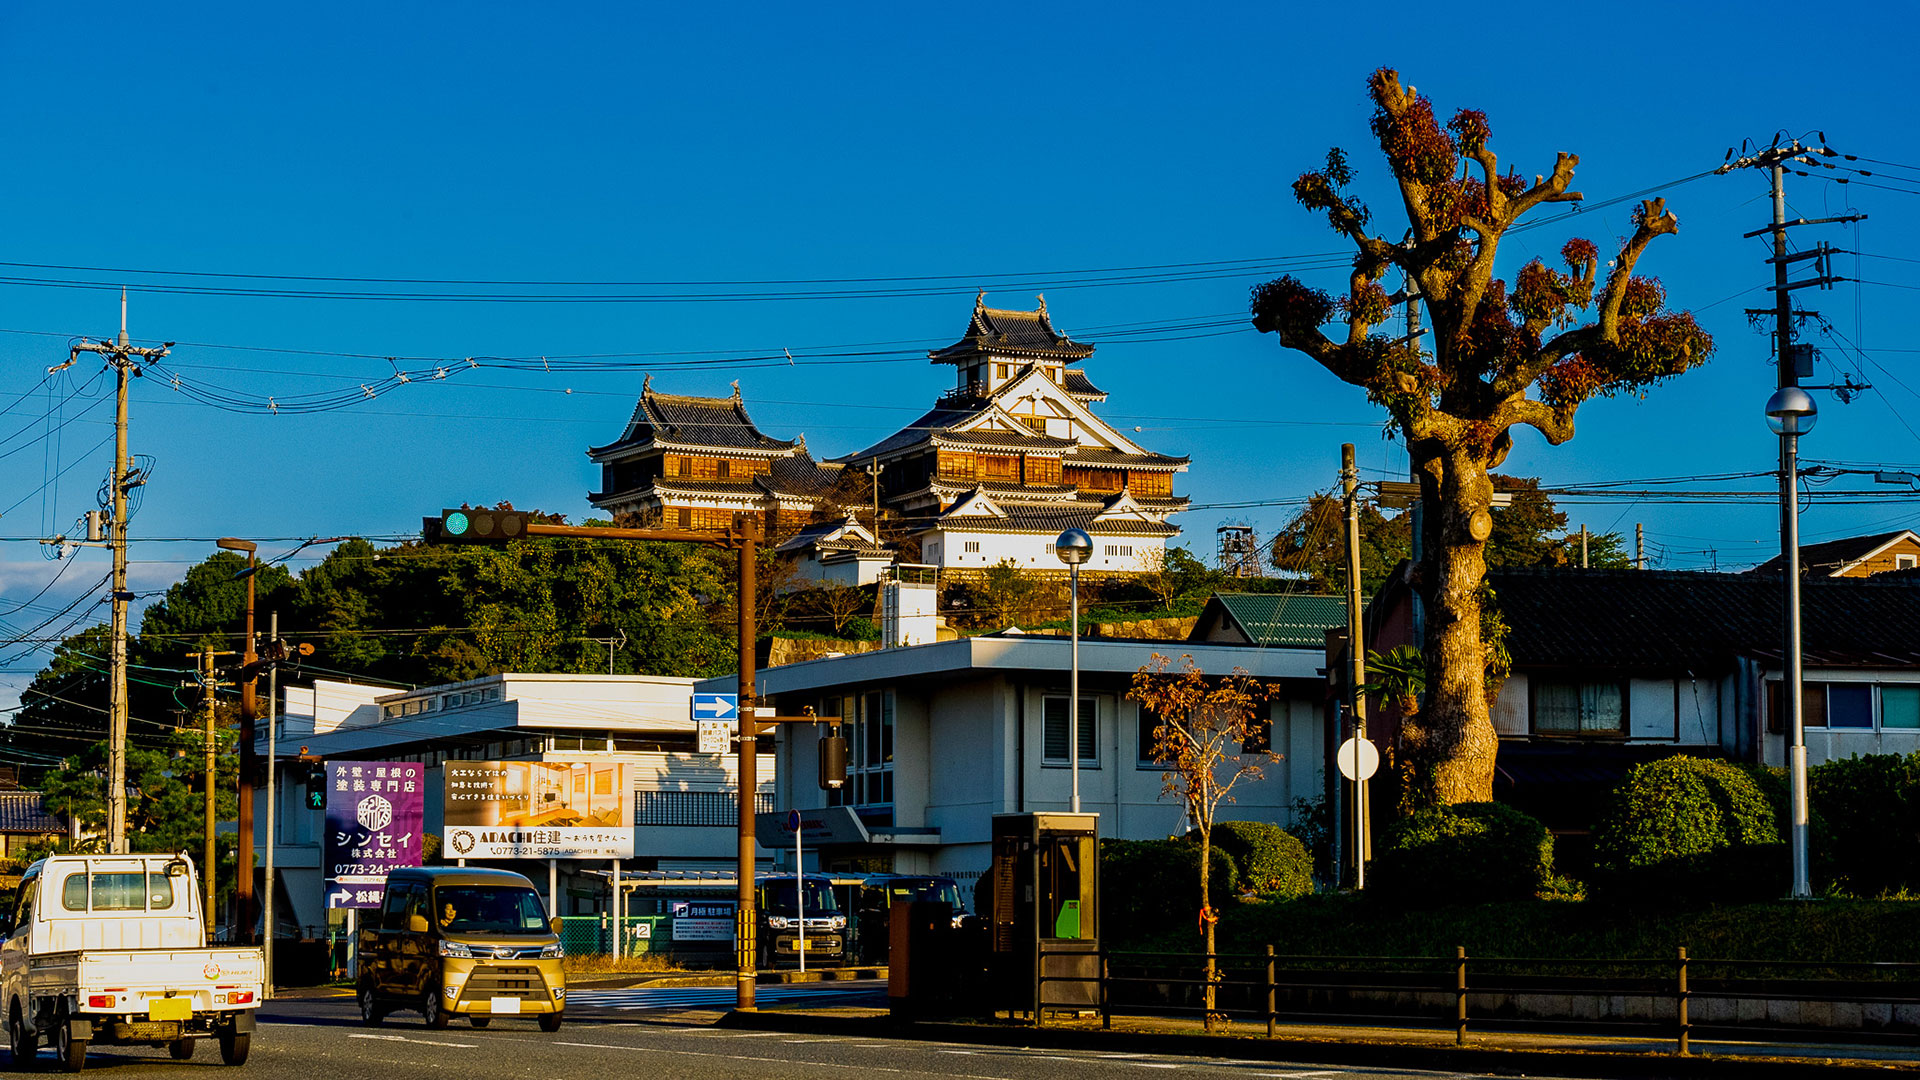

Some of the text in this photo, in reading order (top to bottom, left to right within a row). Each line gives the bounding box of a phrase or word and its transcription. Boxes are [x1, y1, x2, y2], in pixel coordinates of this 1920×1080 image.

[336, 766, 416, 778] 外壁・屋根の
[451, 769, 508, 777] 大工ならではの
[336, 779, 416, 792] 塗装専門店
[450, 781, 495, 789] 知恵と技術で
[336, 831, 413, 848] シンセイ
[479, 830, 562, 845] ADACHI住建
[351, 848, 397, 859] 株式会社
[496, 847, 560, 856] 0773-21-5875
[639, 925, 648, 936] 2
